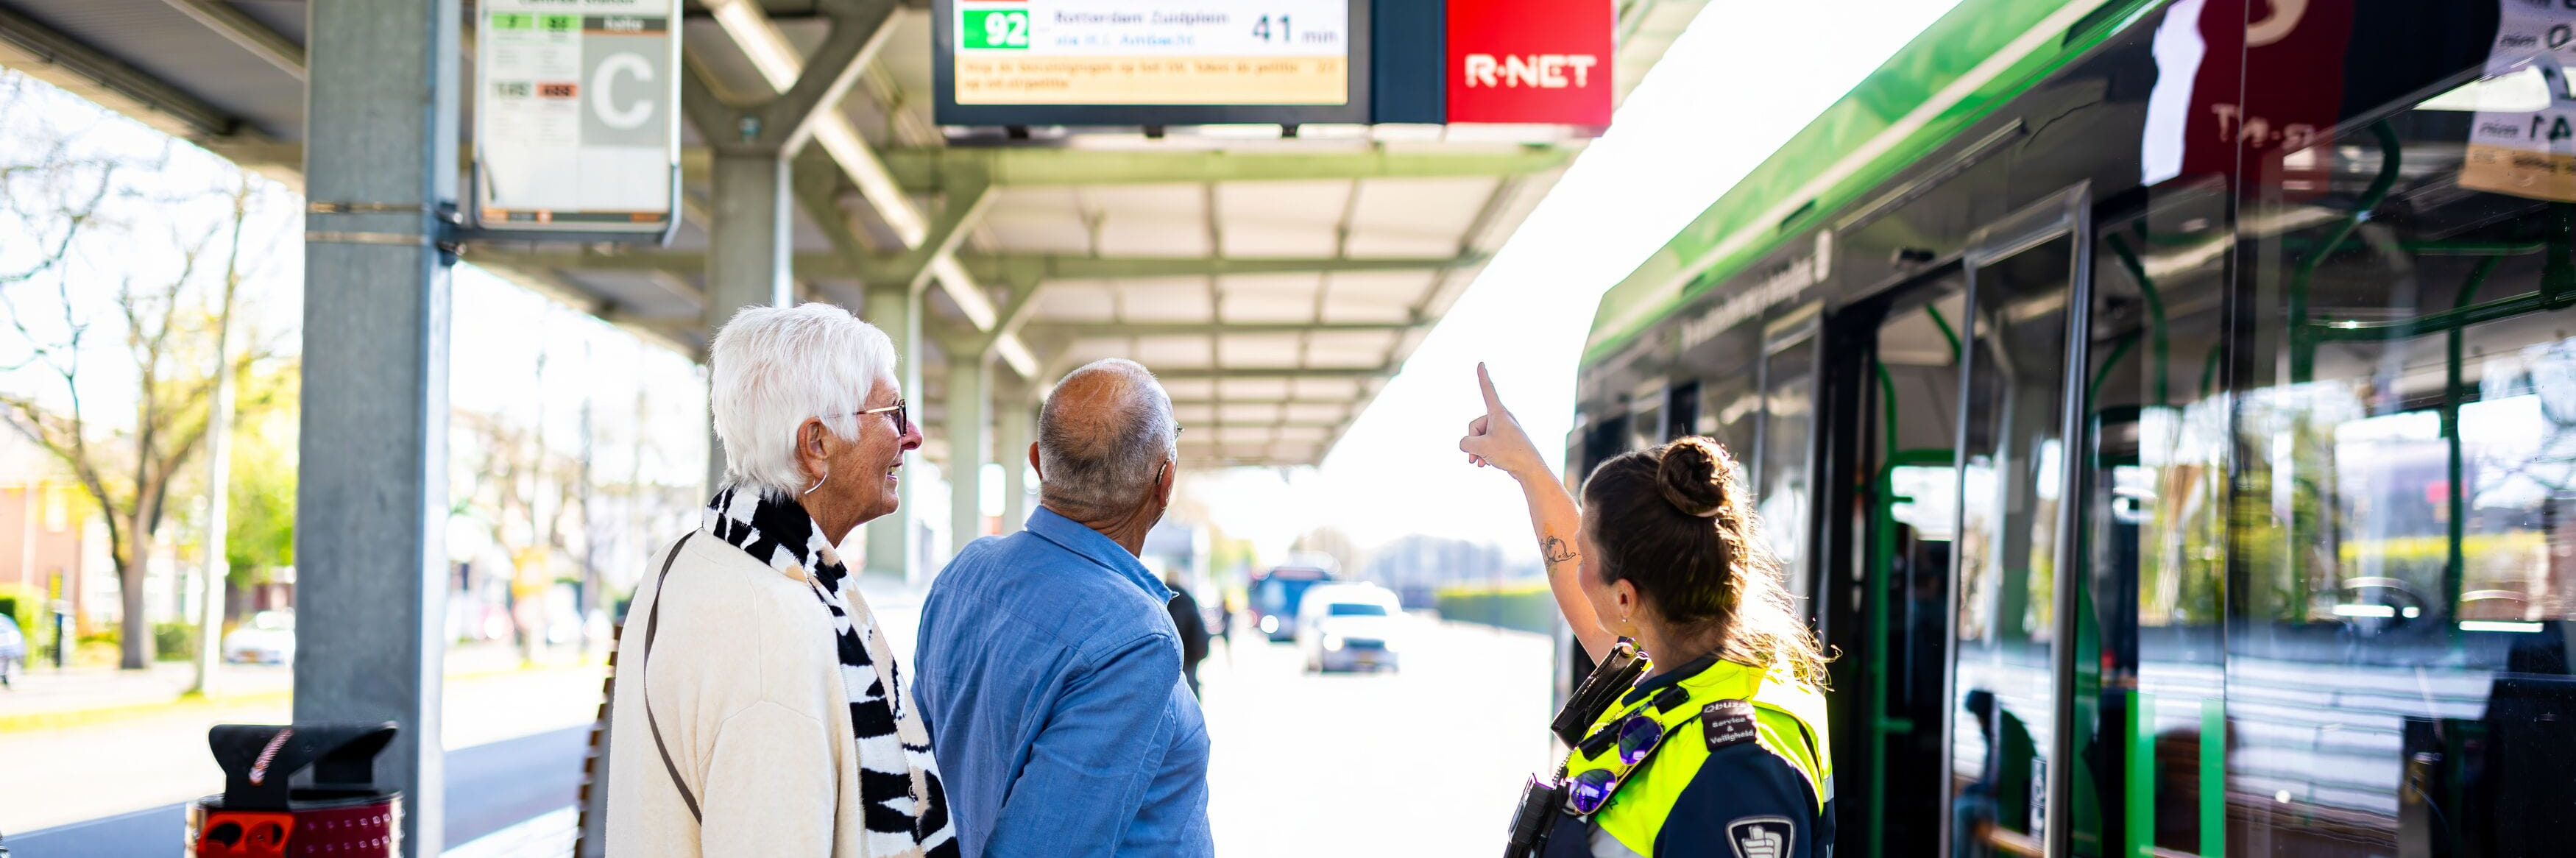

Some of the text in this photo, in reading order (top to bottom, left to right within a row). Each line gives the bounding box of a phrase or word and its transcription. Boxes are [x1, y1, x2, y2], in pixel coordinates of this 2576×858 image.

[983, 10, 1337, 46] 92 Rotterdam Zuidplein 41 min
[591, 51, 655, 131] C
[1712, 717, 1747, 728] Service
[1710, 729, 1755, 745] Veiligheid
